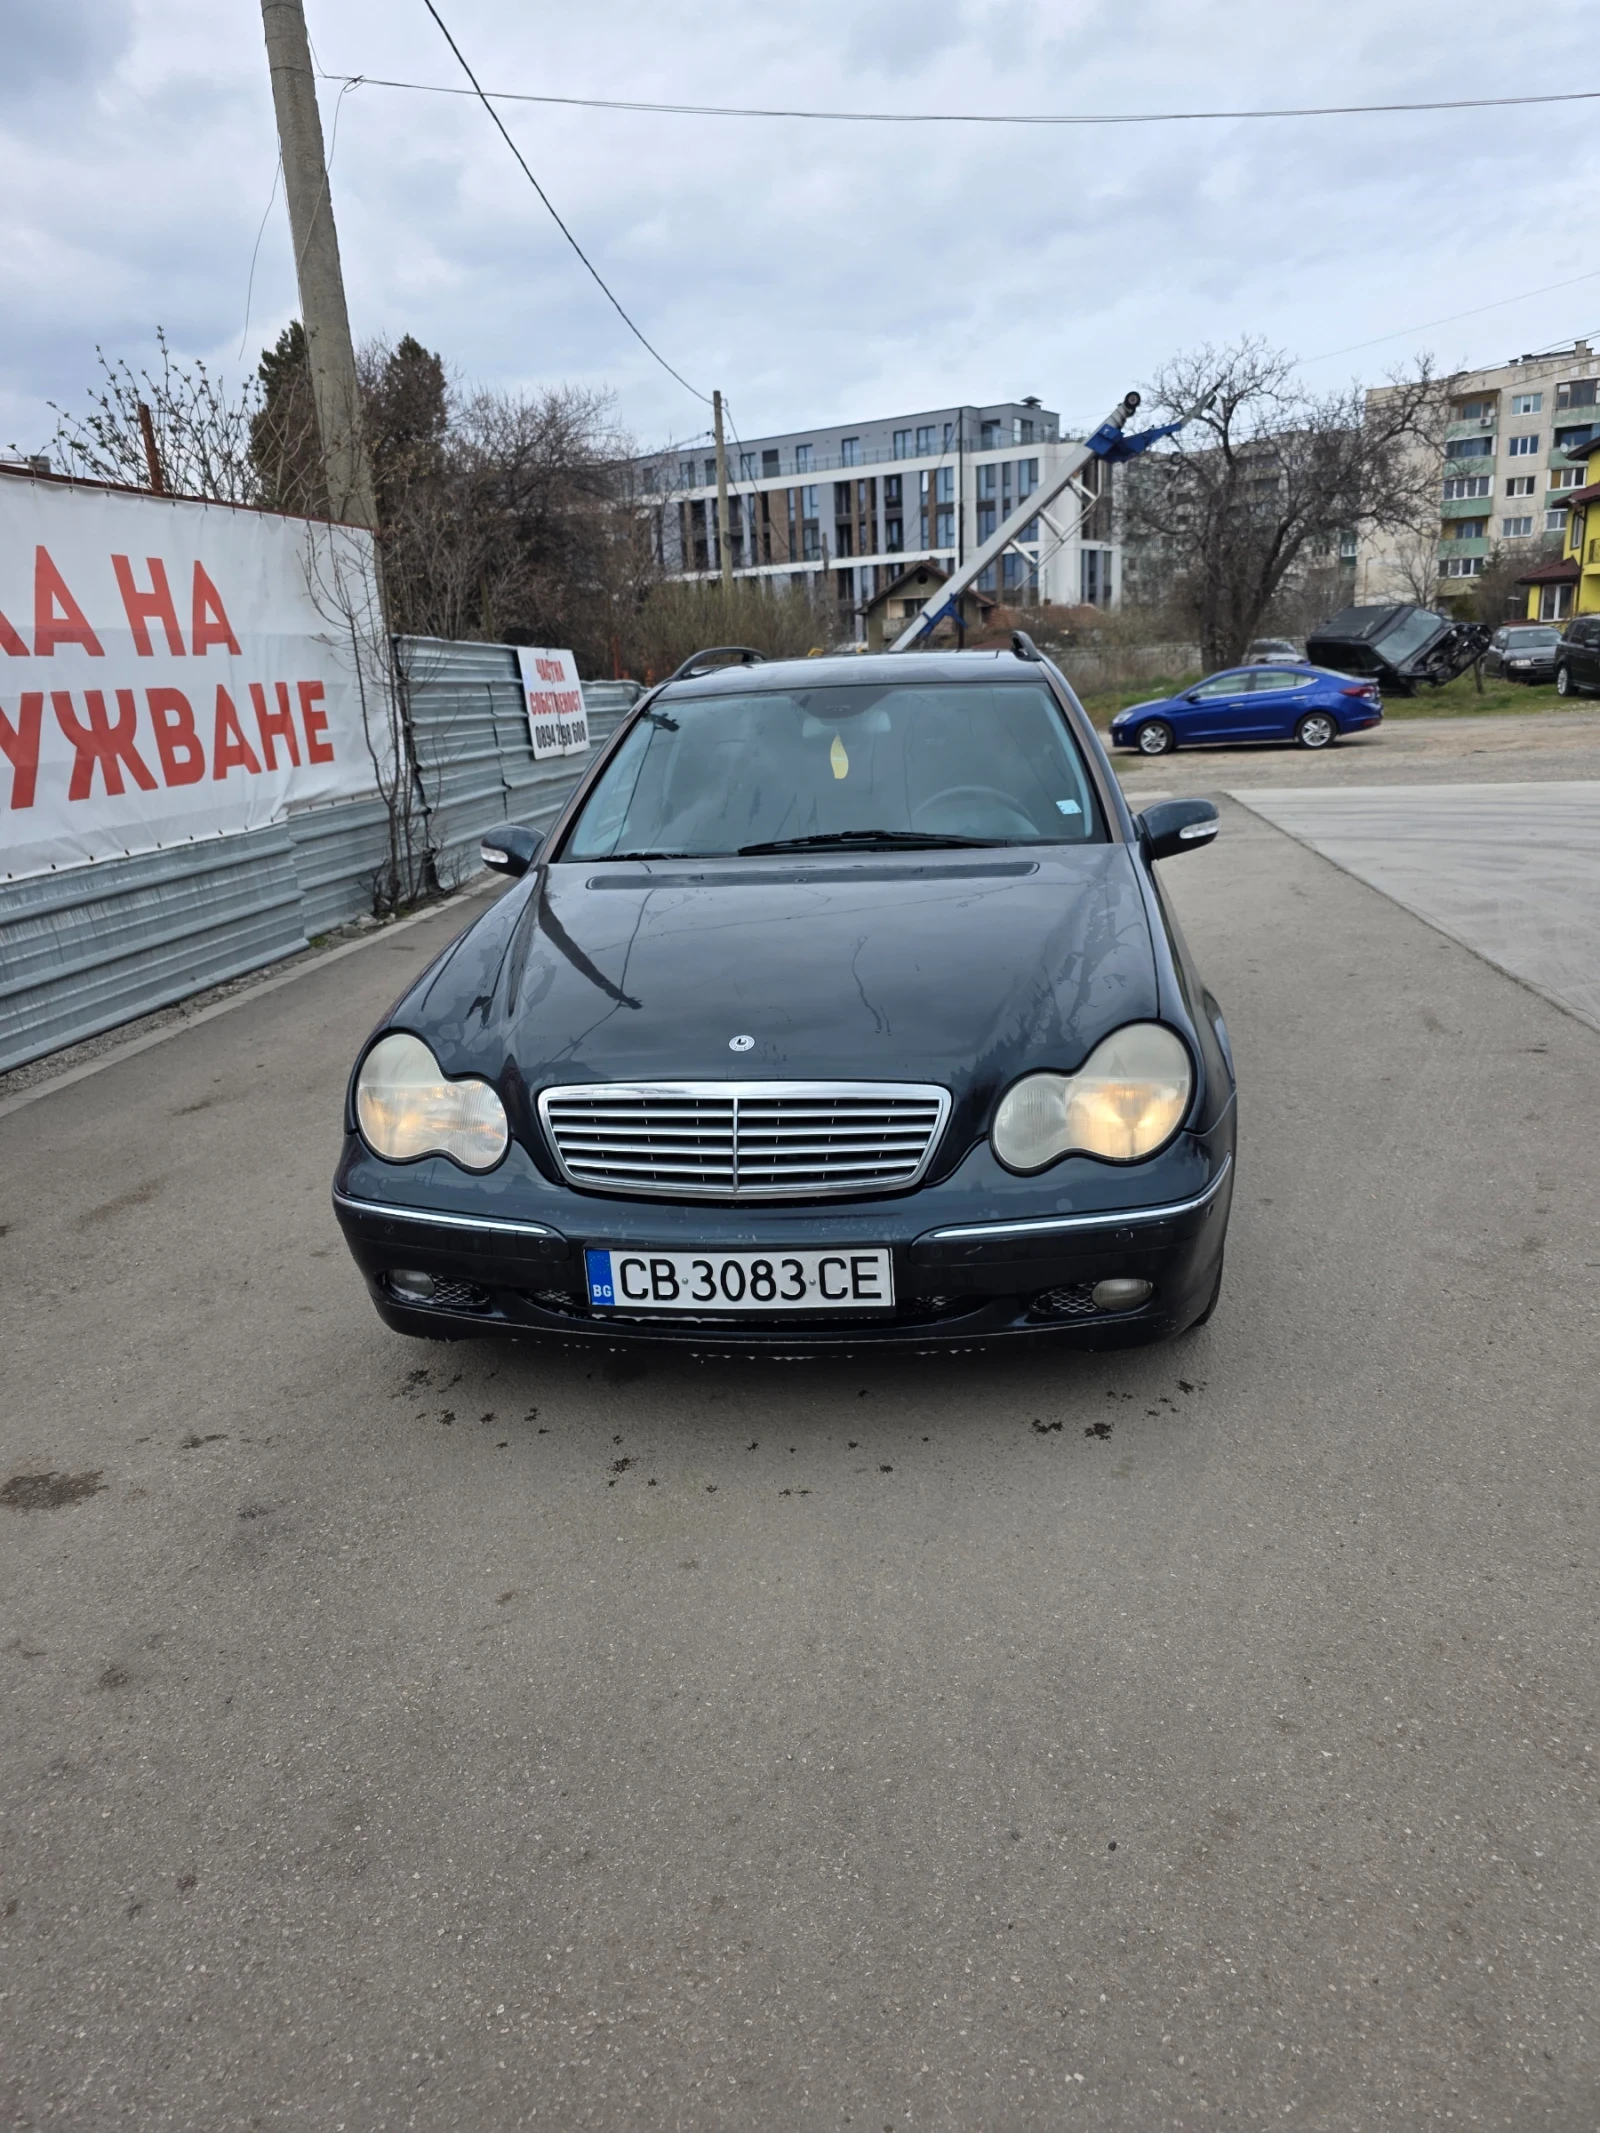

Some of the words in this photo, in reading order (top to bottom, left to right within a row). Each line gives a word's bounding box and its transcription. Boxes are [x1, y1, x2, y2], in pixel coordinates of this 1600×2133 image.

[111, 554, 242, 657] НА
[0, 681, 335, 810] УЖВАНЕ
[535, 724, 556, 749] 0894
[593, 1284, 612, 1298] BG
[619, 1258, 680, 1301] CB
[692, 1258, 807, 1302] 3083
[818, 1256, 882, 1300] CE
